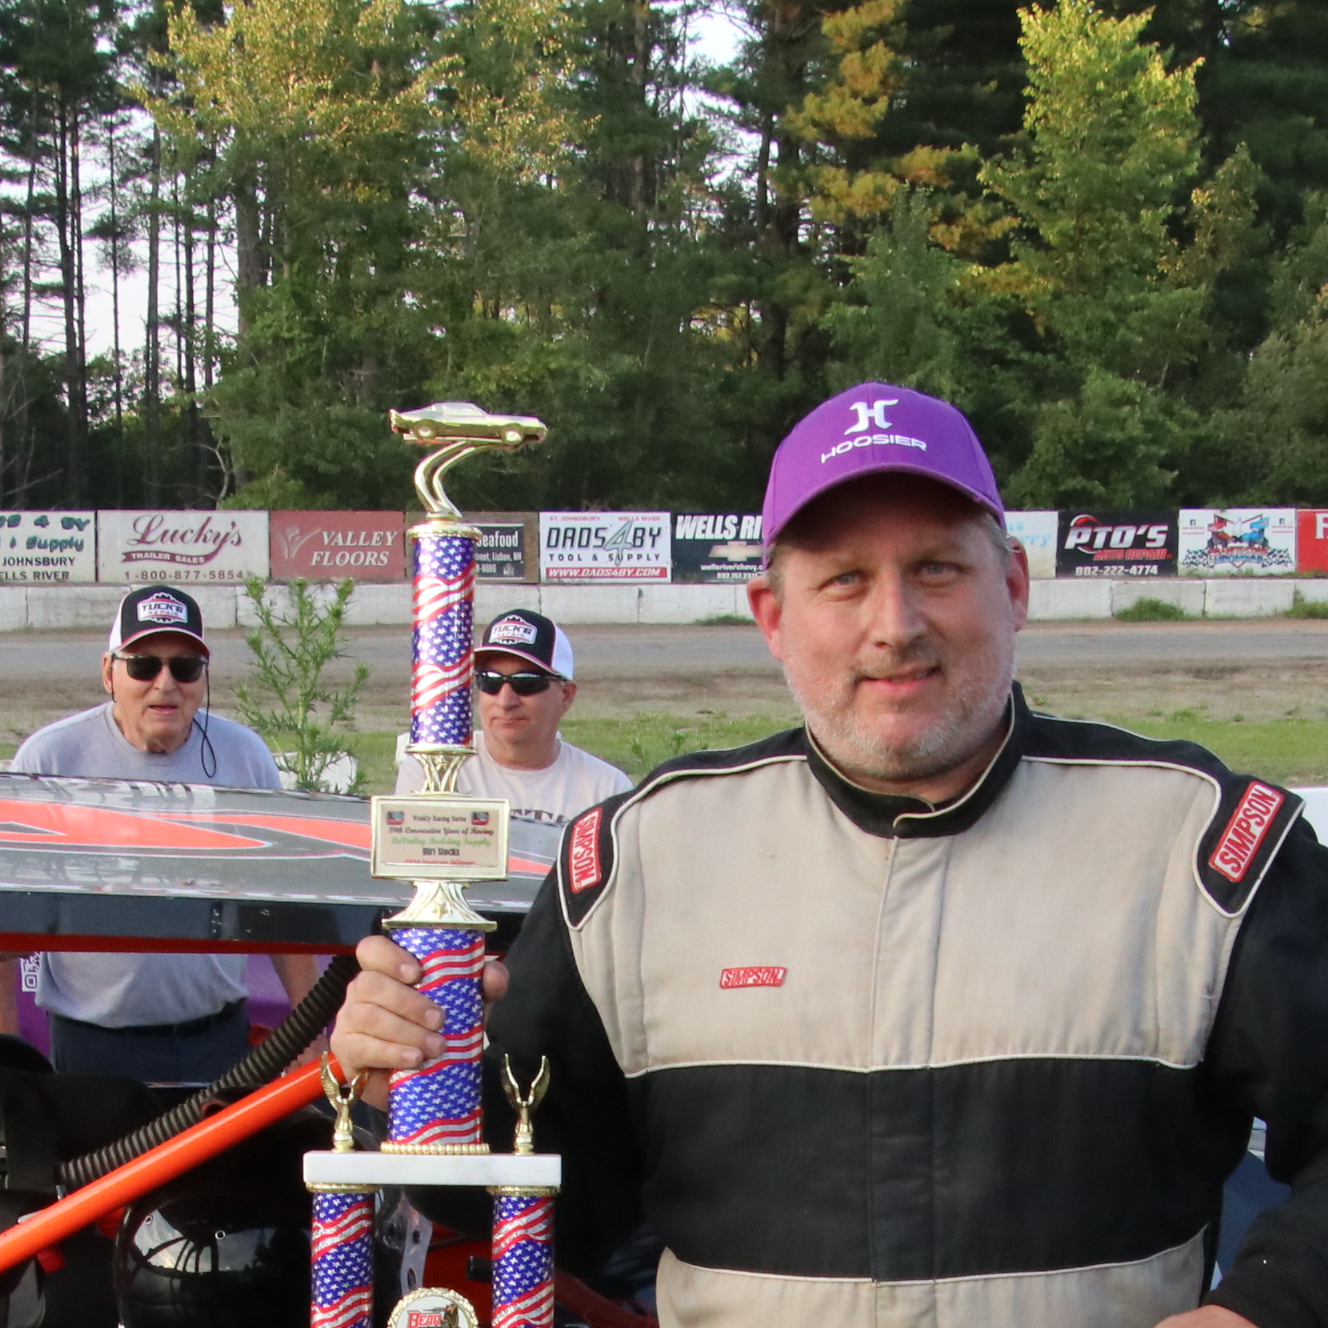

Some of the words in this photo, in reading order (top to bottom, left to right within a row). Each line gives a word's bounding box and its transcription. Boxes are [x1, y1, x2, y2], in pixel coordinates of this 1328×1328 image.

[821, 434, 928, 464] HOOSIER
[33, 514, 50, 528] 4
[675, 514, 739, 540] WELLS
[126, 514, 243, 552] Lucky's
[322, 530, 399, 547] VALLEY
[1064, 524, 1169, 550] PTO'S
[25, 536, 85, 553] Supply
[2, 557, 76, 567] JOHNSBURY
[130, 552, 171, 561] TRAILER
[175, 555, 206, 564] SALES
[310, 551, 390, 567] FLOORS
[548, 553, 583, 562] TOOL
[608, 553, 661, 562] SUPPLY
[33, 571, 70, 581] RIVER
[548, 567, 662, 577] WWW.DADS4BY.COM
[1075, 565, 1159, 576] 802-222-4774
[1218, 787, 1278, 874] SIMPSON
[573, 814, 597, 884] SIMPSON
[724, 969, 779, 987] SIMPSON
